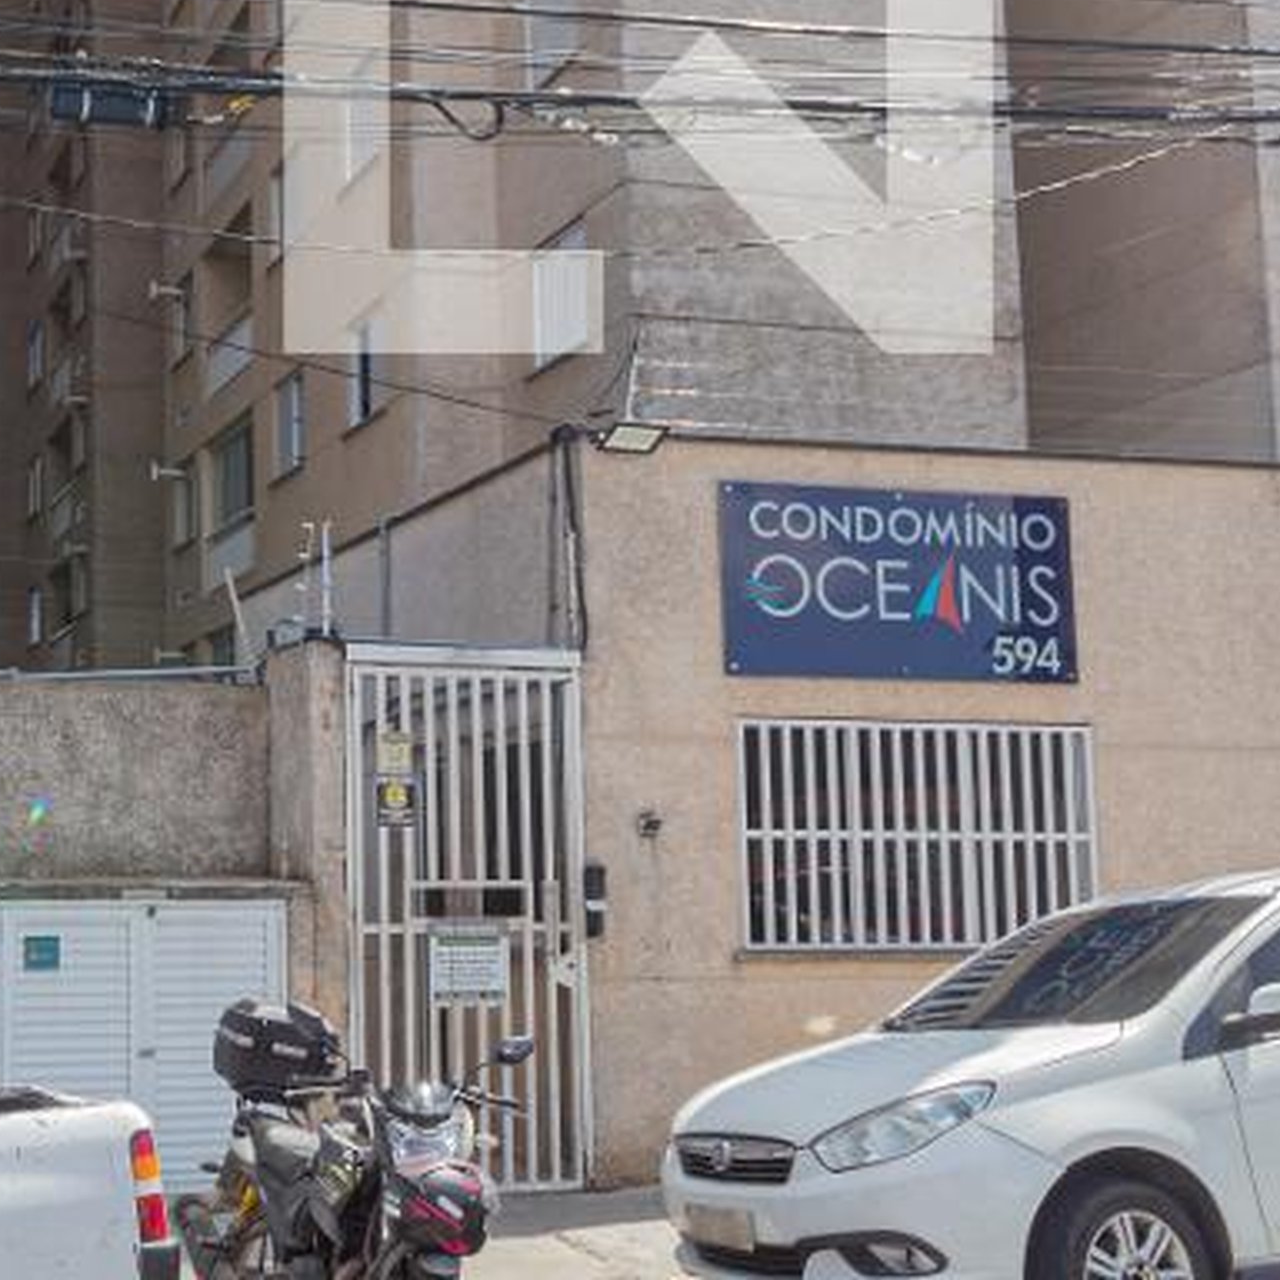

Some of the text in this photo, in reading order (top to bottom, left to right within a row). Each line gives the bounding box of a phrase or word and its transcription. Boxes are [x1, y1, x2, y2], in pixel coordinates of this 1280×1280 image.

[749, 500, 1056, 551] CONDOMÍNIO
[746, 553, 1059, 631] OCEANIS
[992, 637, 1061, 674] 594
